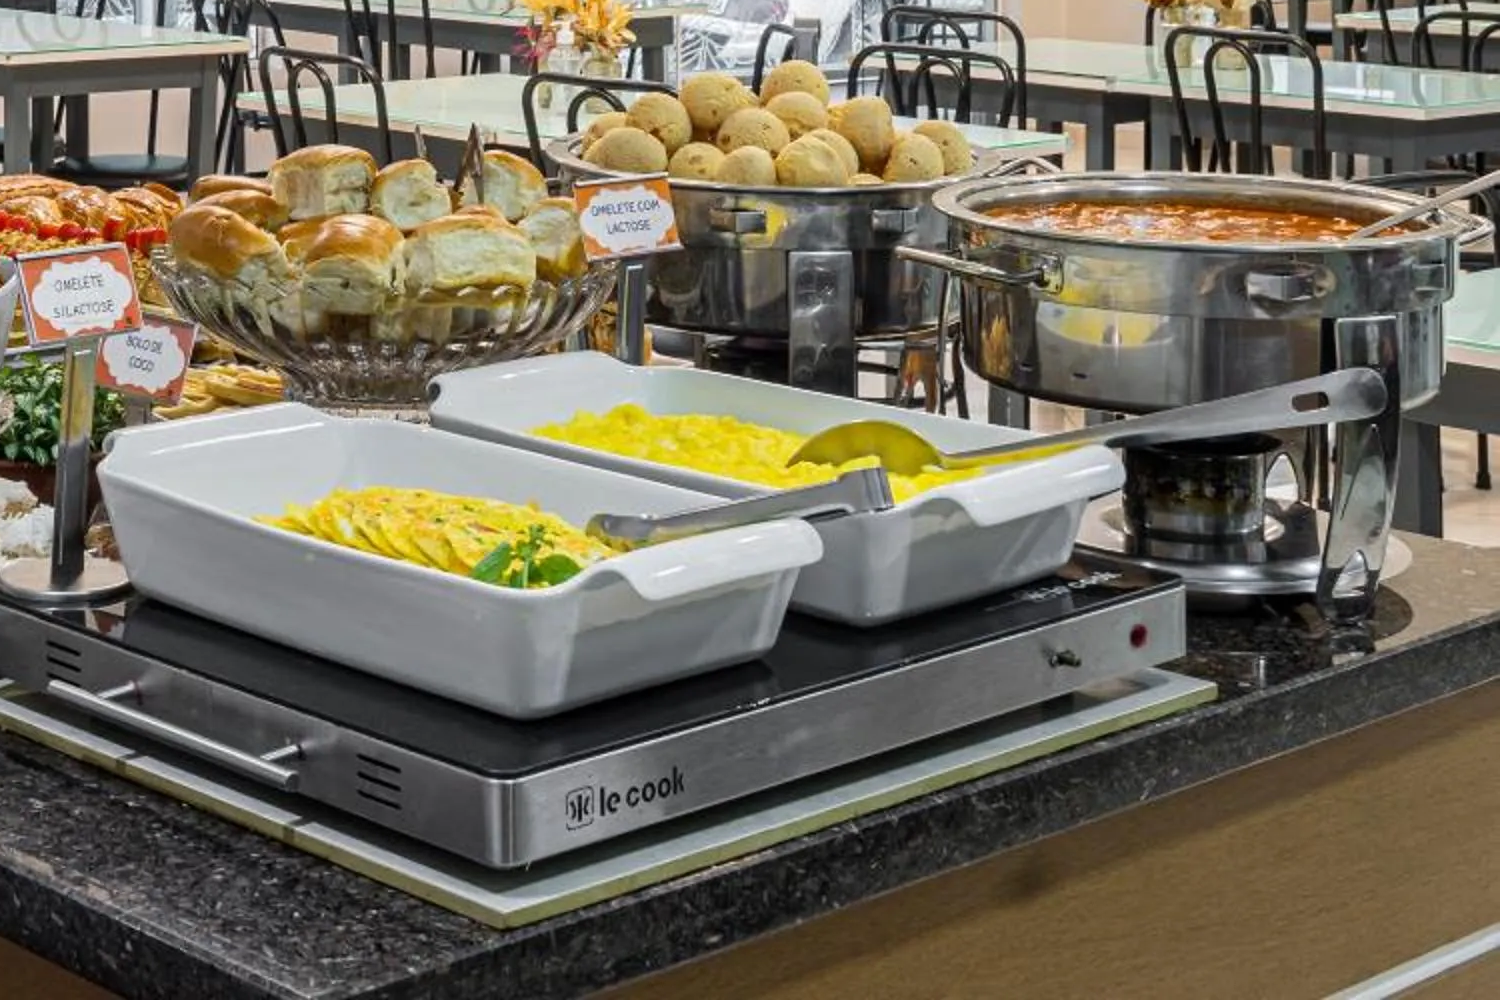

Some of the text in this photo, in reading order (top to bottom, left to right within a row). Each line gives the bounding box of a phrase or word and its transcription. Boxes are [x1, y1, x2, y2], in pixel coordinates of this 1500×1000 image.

[591, 199, 660, 217] OMELETE COM
[606, 219, 651, 235] LACTOSE
[54, 274, 105, 292] OMELETE
[128, 355, 156, 372] COCO
[599, 765, 685, 817] le cook
